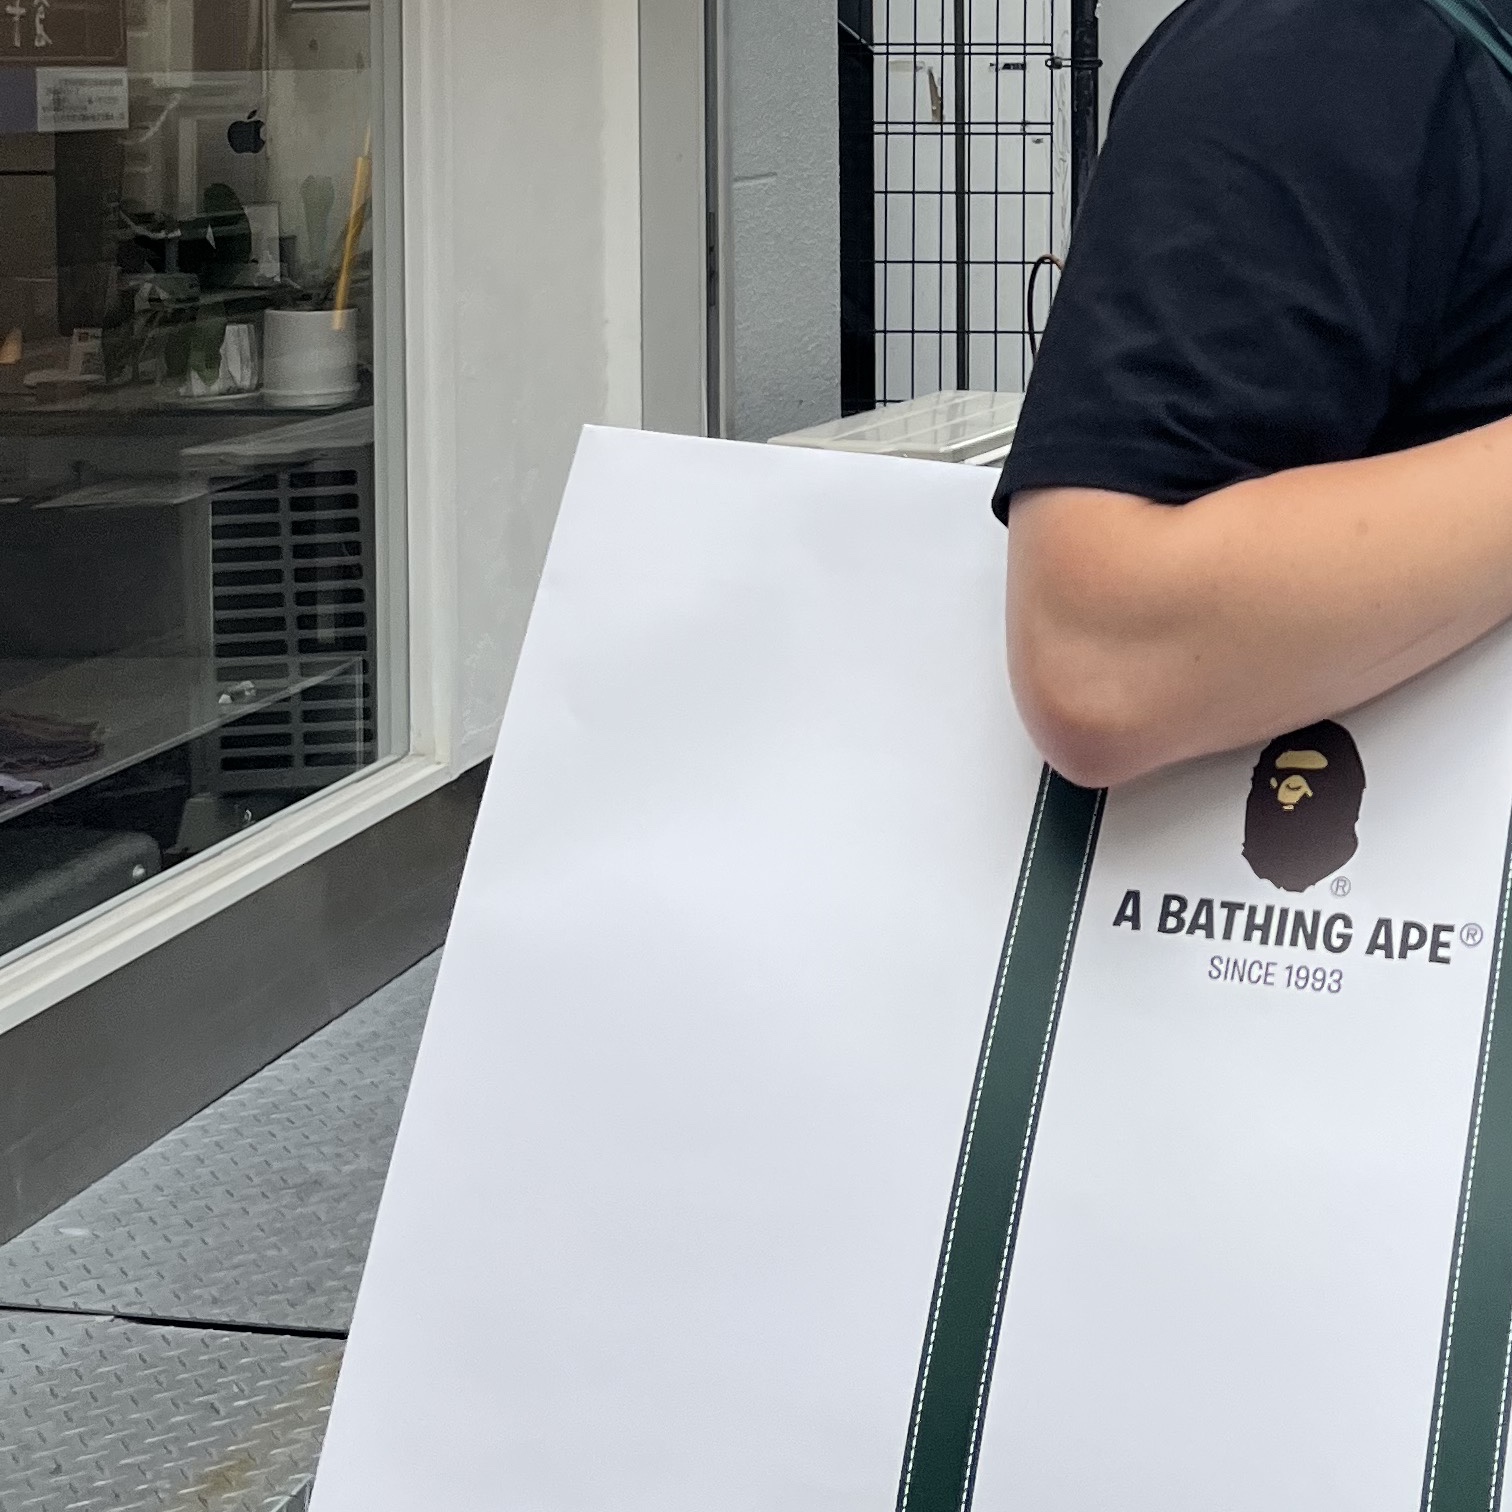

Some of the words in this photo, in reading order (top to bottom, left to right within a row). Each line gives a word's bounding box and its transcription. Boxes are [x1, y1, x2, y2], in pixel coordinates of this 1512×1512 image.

[1112, 889, 1142, 931] A
[1157, 893, 1354, 954] BATHING
[1208, 955, 1278, 987] SINCE
[1285, 965, 1344, 995] 1993
